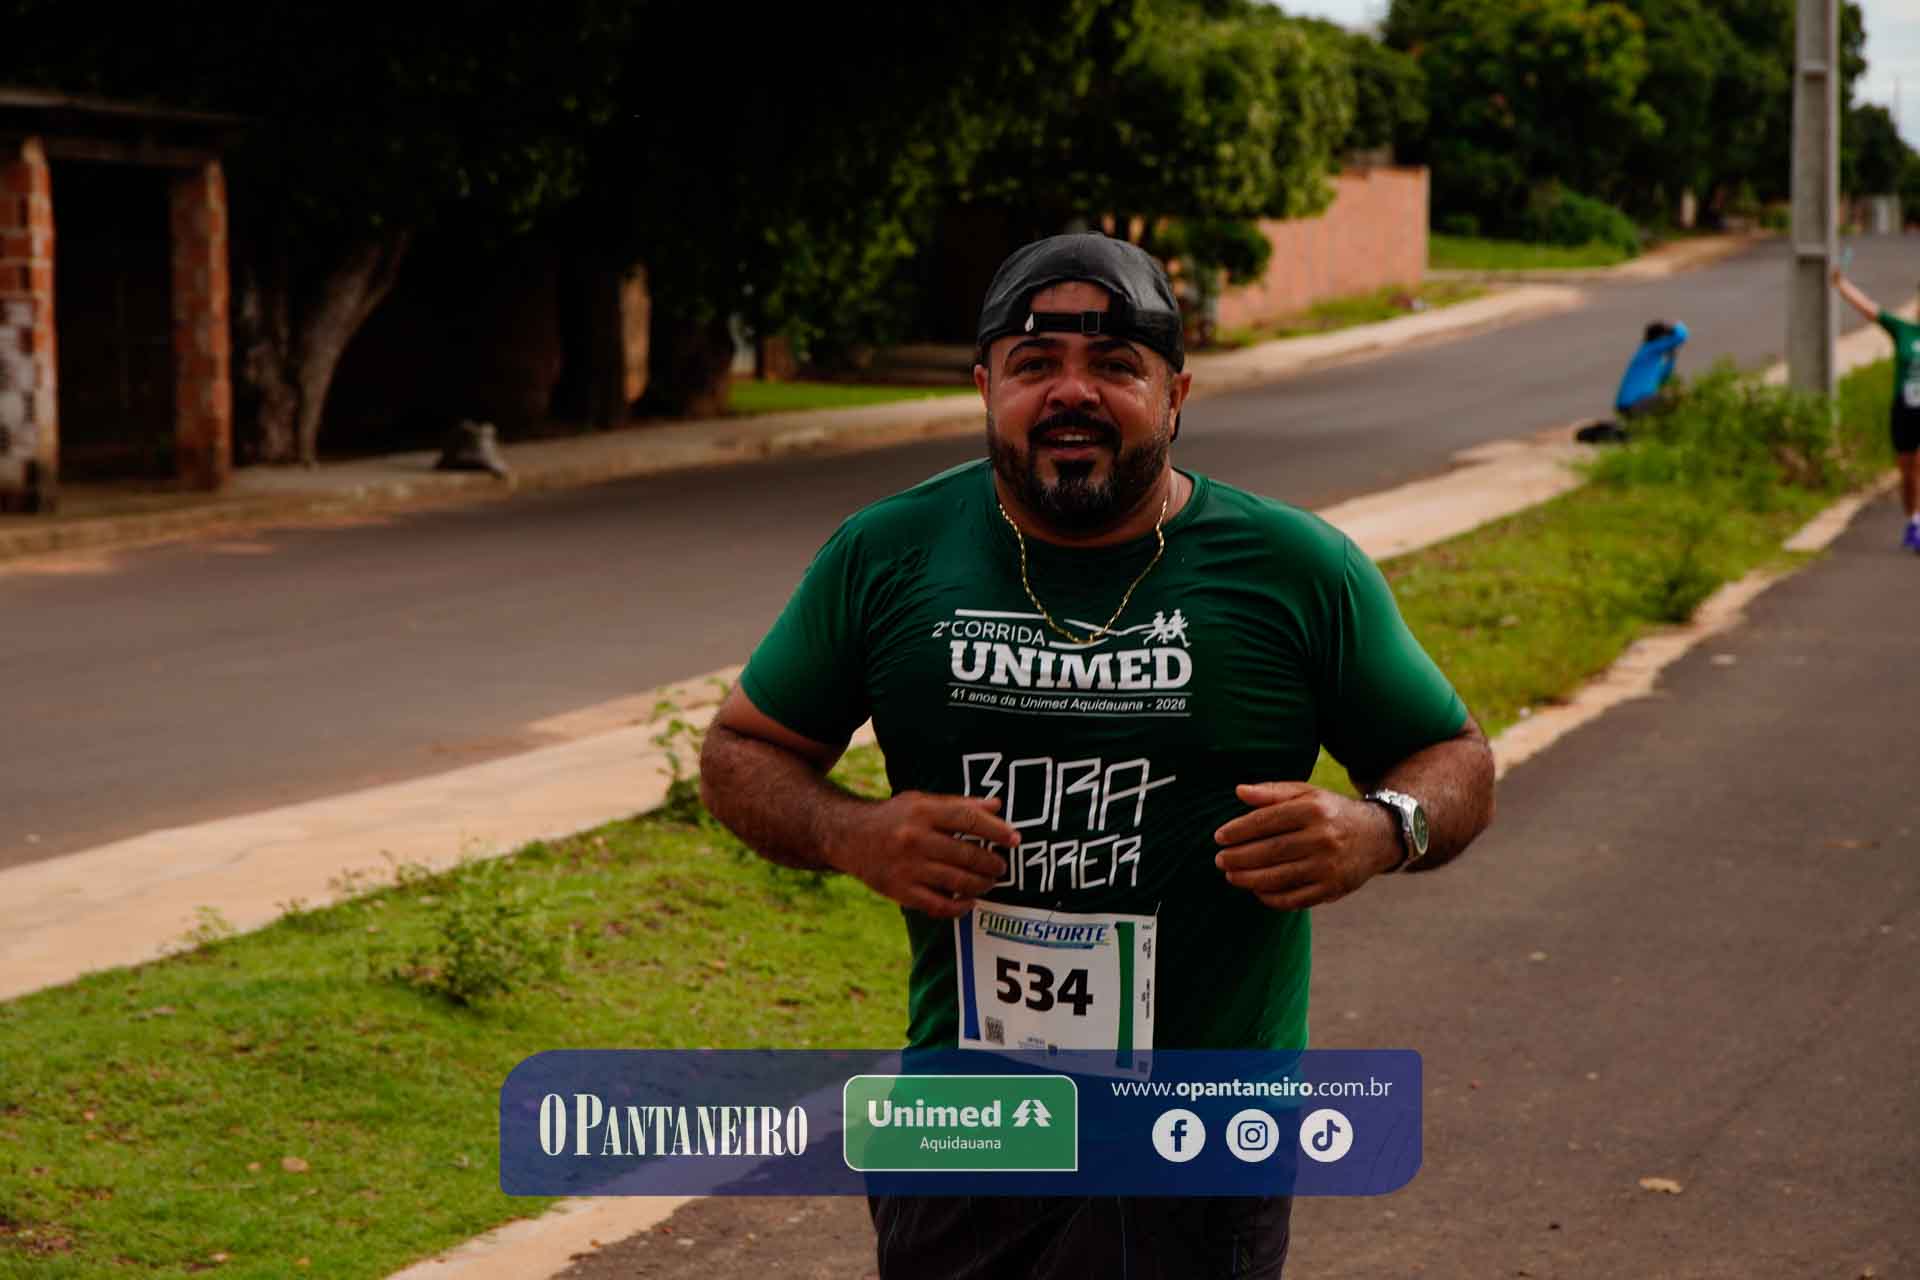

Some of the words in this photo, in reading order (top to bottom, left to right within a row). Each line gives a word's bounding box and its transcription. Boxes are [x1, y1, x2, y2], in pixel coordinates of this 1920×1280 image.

[951, 620, 1046, 647] CORRIDA
[949, 640, 1193, 690] UNIMED
[950, 688, 965, 700] 41
[968, 692, 997, 704] anos
[1000, 695, 1016, 706] da
[1019, 696, 1068, 710] Unimed
[1070, 698, 1144, 713] Aquidauana
[1155, 698, 1186, 711] 2026
[962, 752, 1177, 832] BORA
[953, 832, 1142, 893] ORRER
[995, 957, 1094, 1017] 534
